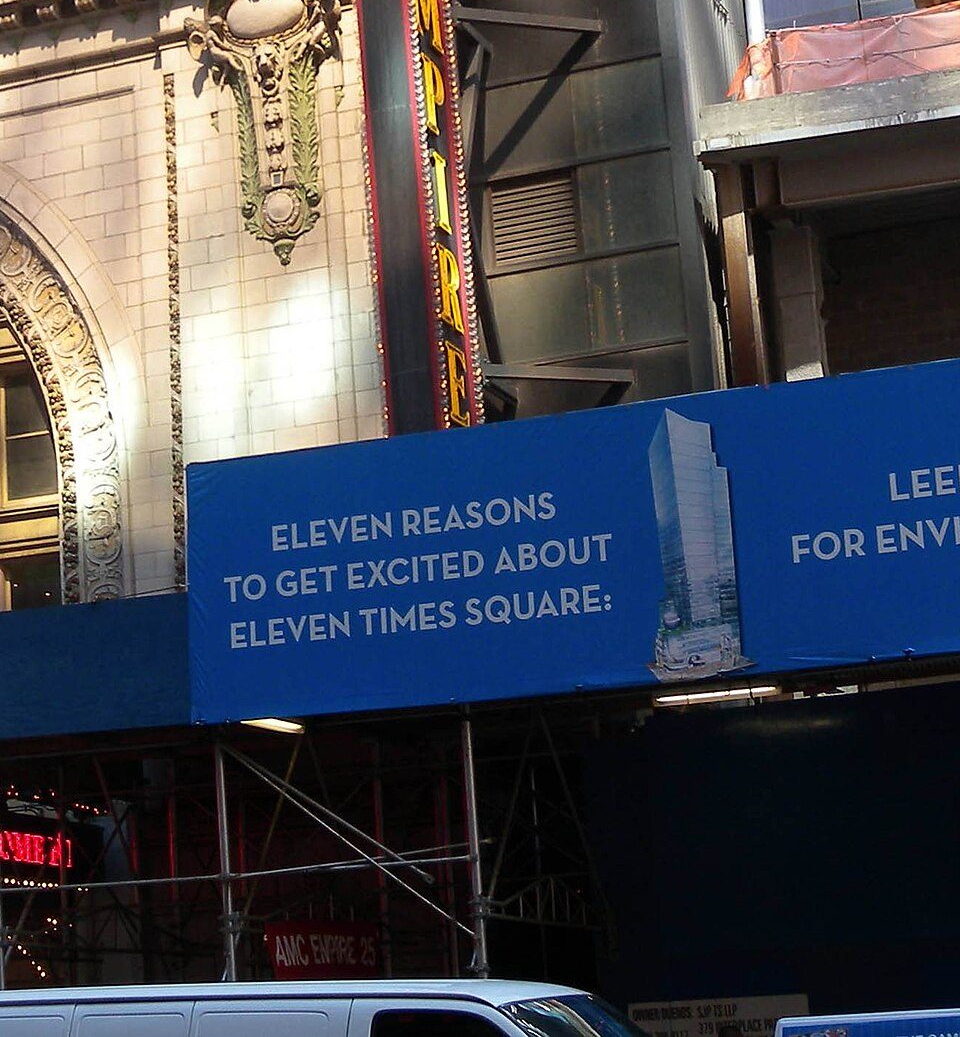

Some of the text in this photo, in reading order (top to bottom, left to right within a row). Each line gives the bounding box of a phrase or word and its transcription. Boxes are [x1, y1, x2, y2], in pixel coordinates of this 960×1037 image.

[889, 465, 960, 501] LEE
[271, 493, 556, 551] ELEVEN REASONS
[223, 534, 612, 603] TO GET EXCITED ABOUT
[791, 529, 866, 563] FOR
[230, 585, 613, 649] ELEVEN TIMES SQUARE:
[275, 934, 309, 967] AMC
